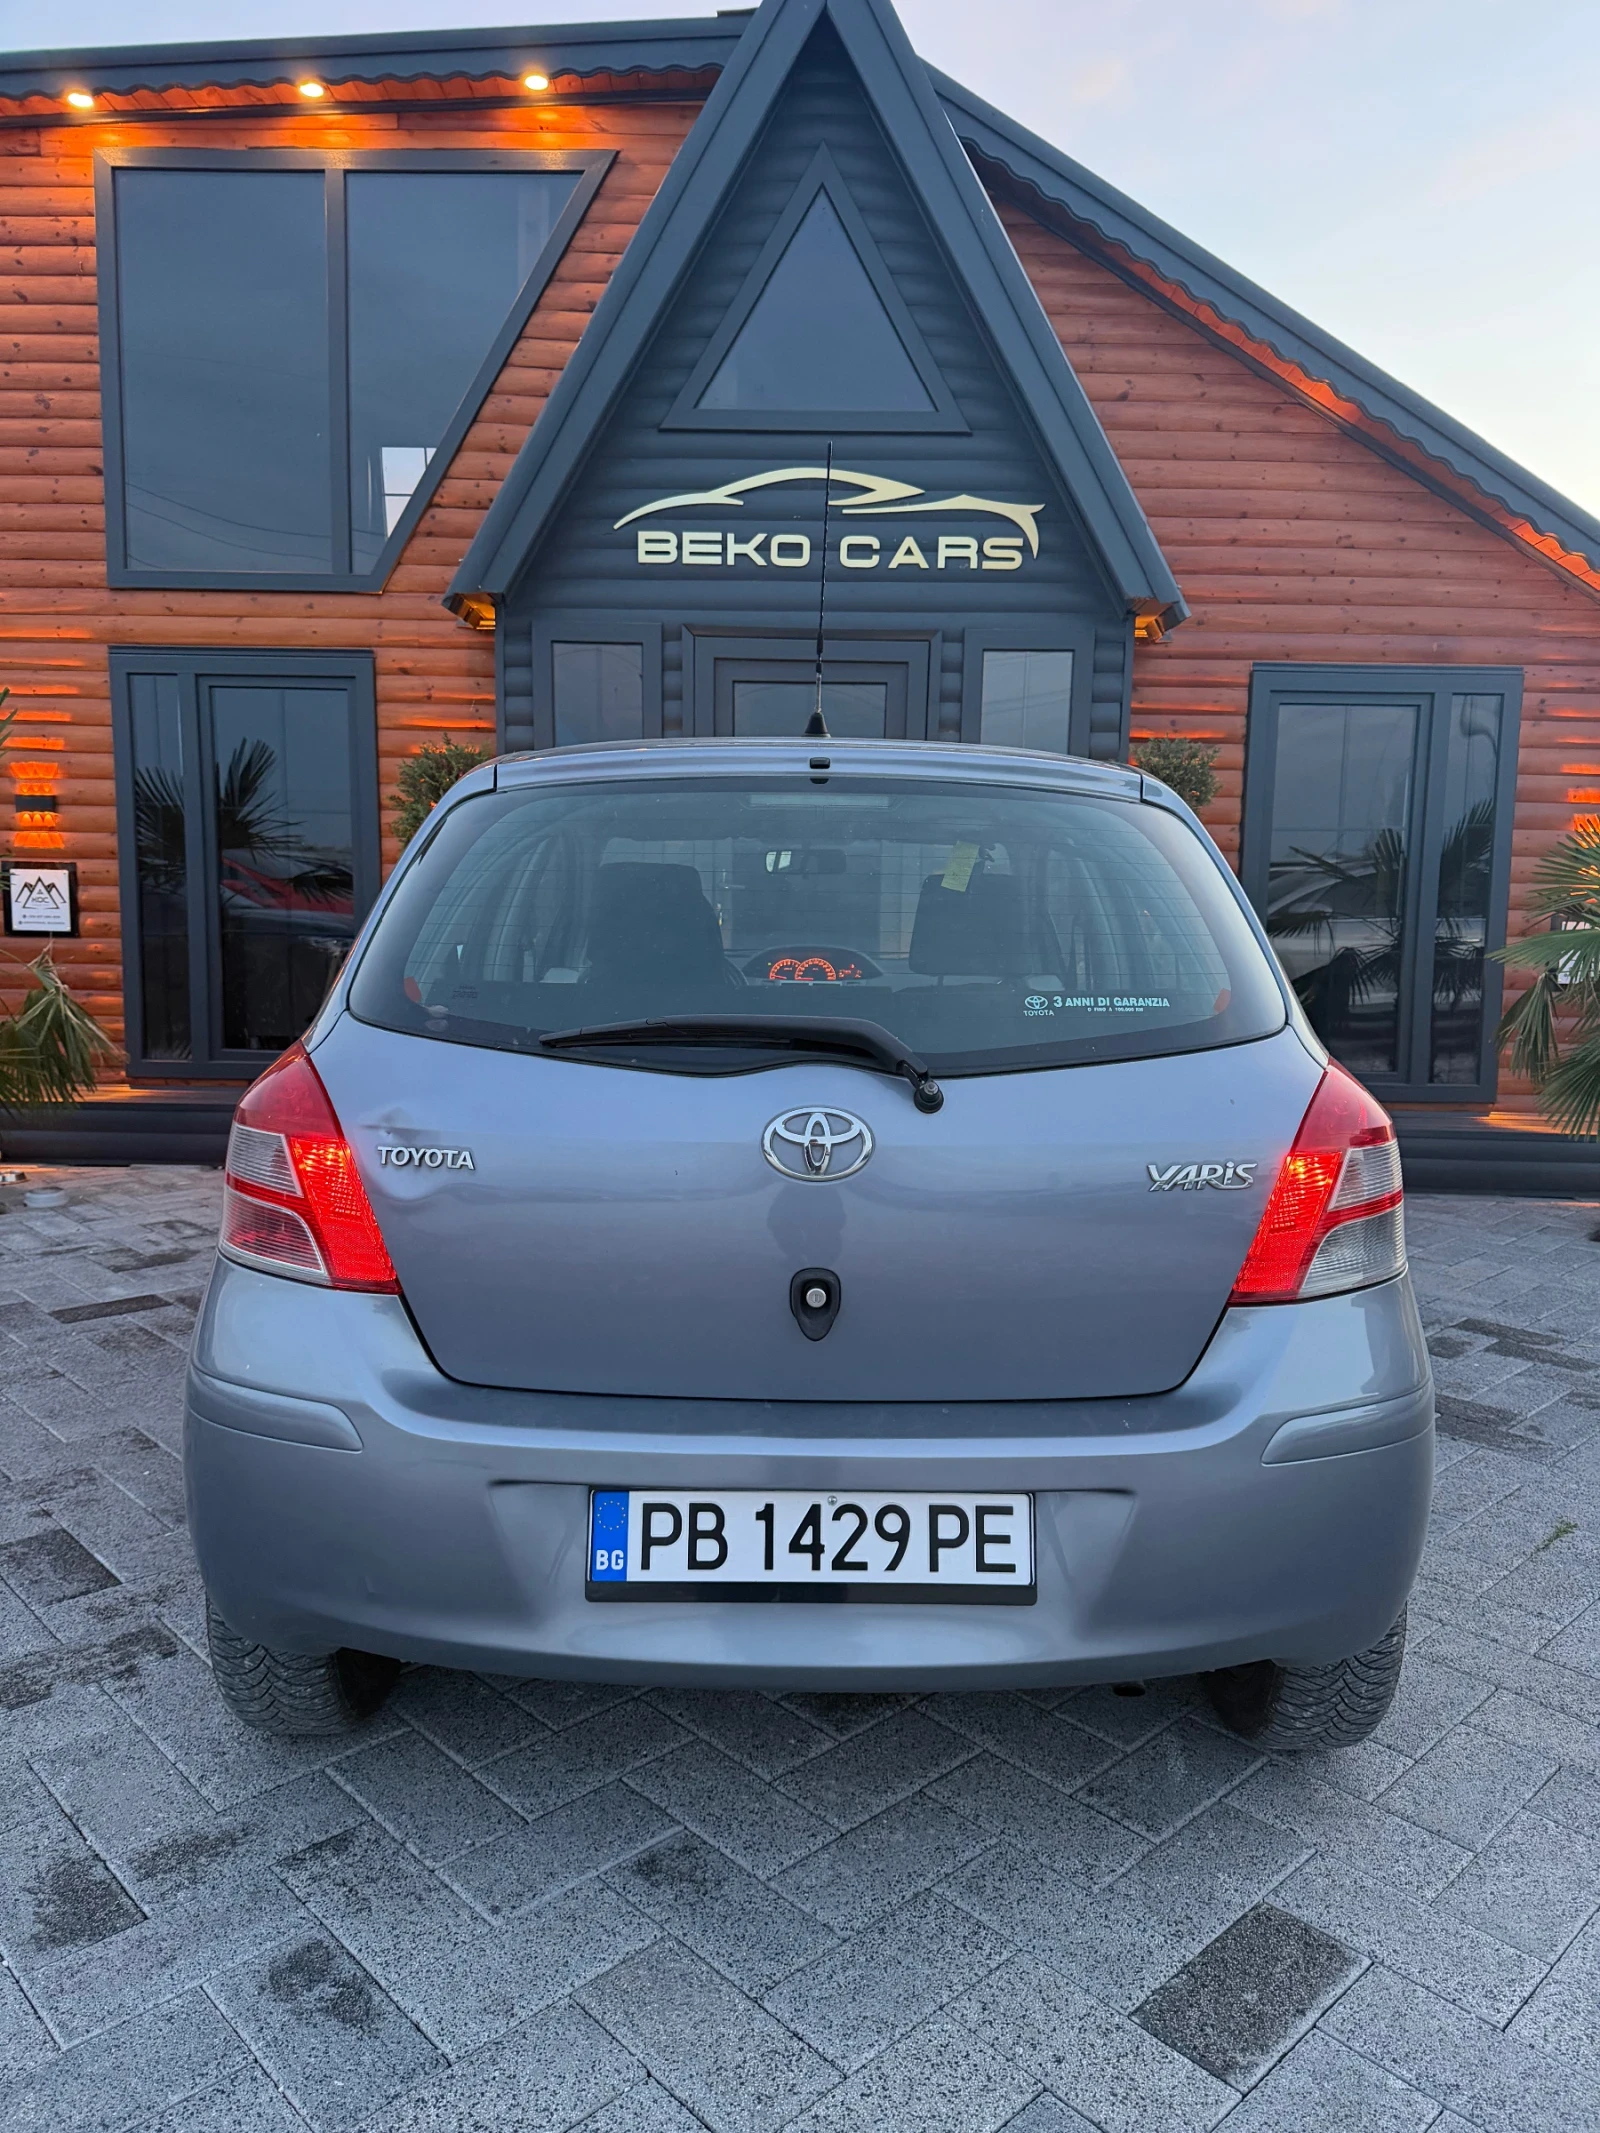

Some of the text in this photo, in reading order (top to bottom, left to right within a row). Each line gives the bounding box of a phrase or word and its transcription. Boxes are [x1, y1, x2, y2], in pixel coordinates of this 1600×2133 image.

[637, 530, 1024, 570] BEKO CARS
[1053, 995, 1170, 1008] 3 ANNI DI GARANZIA
[377, 1145, 475, 1170] TOYOTA
[640, 1502, 1017, 1573] PB 1429 PE
[595, 1549, 625, 1571] BG
